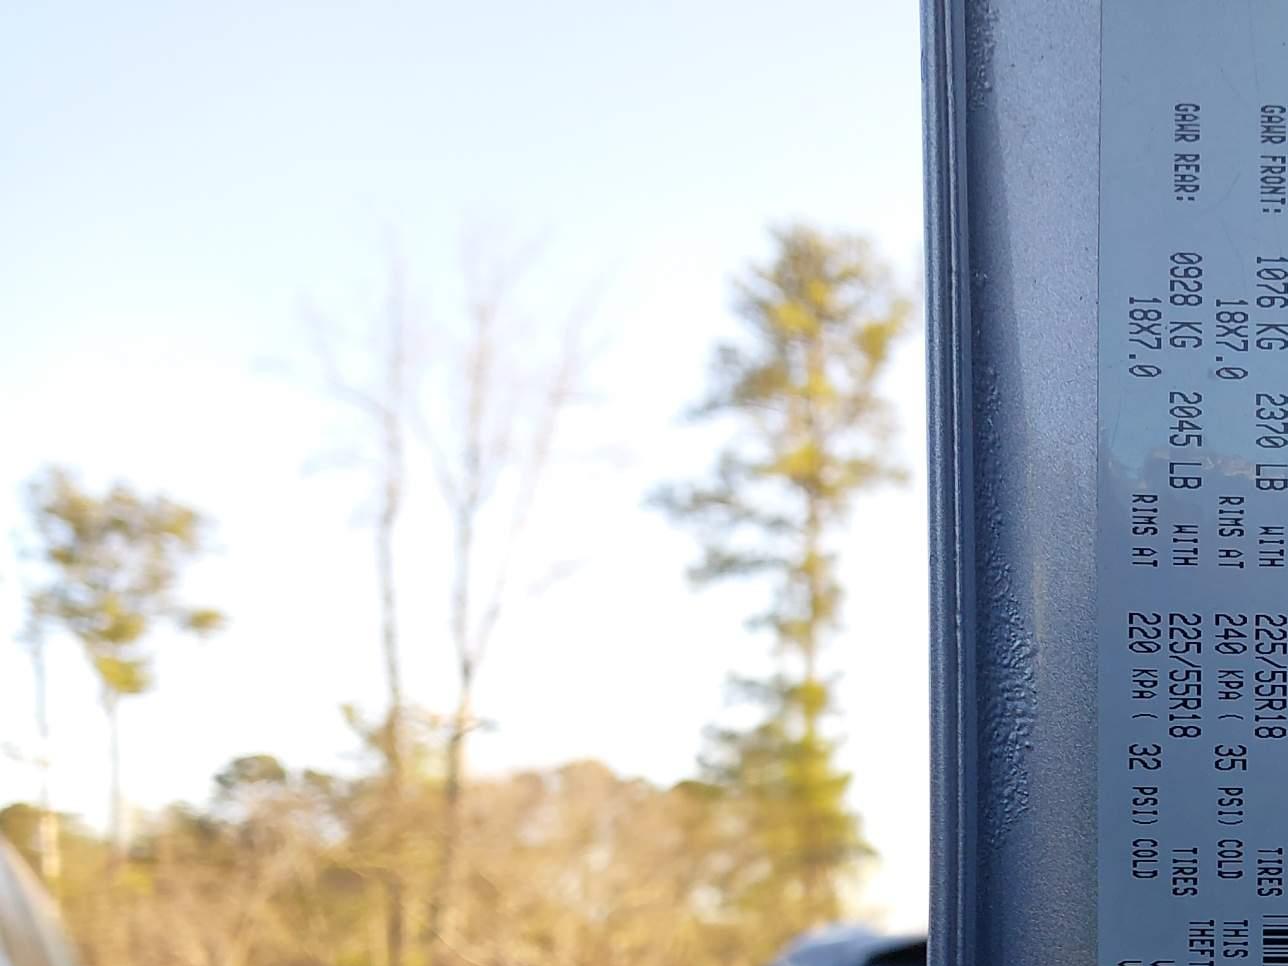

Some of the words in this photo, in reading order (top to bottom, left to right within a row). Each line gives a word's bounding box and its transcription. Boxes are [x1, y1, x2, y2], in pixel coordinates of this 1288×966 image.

[1175, 104, 1200, 142] GAWR
[1261, 105, 1286, 144] GAWR
[1174, 154, 1200, 200] REAR:
[1260, 156, 1286, 213] FRONT:
[1170, 253, 1202, 306] 0928
[1257, 257, 1288, 308] 1076
[1129, 297, 1162, 377] 18X7.0
[1170, 322, 1202, 348] KG
[1216, 300, 1248, 379] 18X7.0
[1256, 324, 1288, 350] KG
[1170, 392, 1202, 446] 2045
[1256, 394, 1288, 448] 2370
[1169, 462, 1202, 489] LB
[1256, 464, 1288, 490] LB
[1132, 495, 1158, 535] RIMS
[1219, 497, 1244, 537] RIMS
[1132, 548, 1158, 567] AT
[1173, 525, 1198, 565] WITH
[1219, 550, 1244, 568] AT
[1259, 527, 1284, 566] WITH
[1129, 613, 1161, 653] 220
[1215, 614, 1247, 654] 240
[1132, 669, 1158, 699] KPA
[1169, 613, 1201, 737] 225/55R18
[1218, 670, 1244, 700] KPA
[1255, 615, 1287, 738] 225/55R18
[1129, 744, 1161, 770] 32
[1215, 745, 1246, 770] 35
[1133, 787, 1158, 824] PSI)
[1218, 788, 1243, 825] PSI)
[1133, 839, 1158, 878] COLD
[1172, 848, 1197, 895] TIRES
[1218, 840, 1243, 878] COLD
[1257, 848, 1282, 896] TIRES
[1223, 920, 1248, 958] THIS
